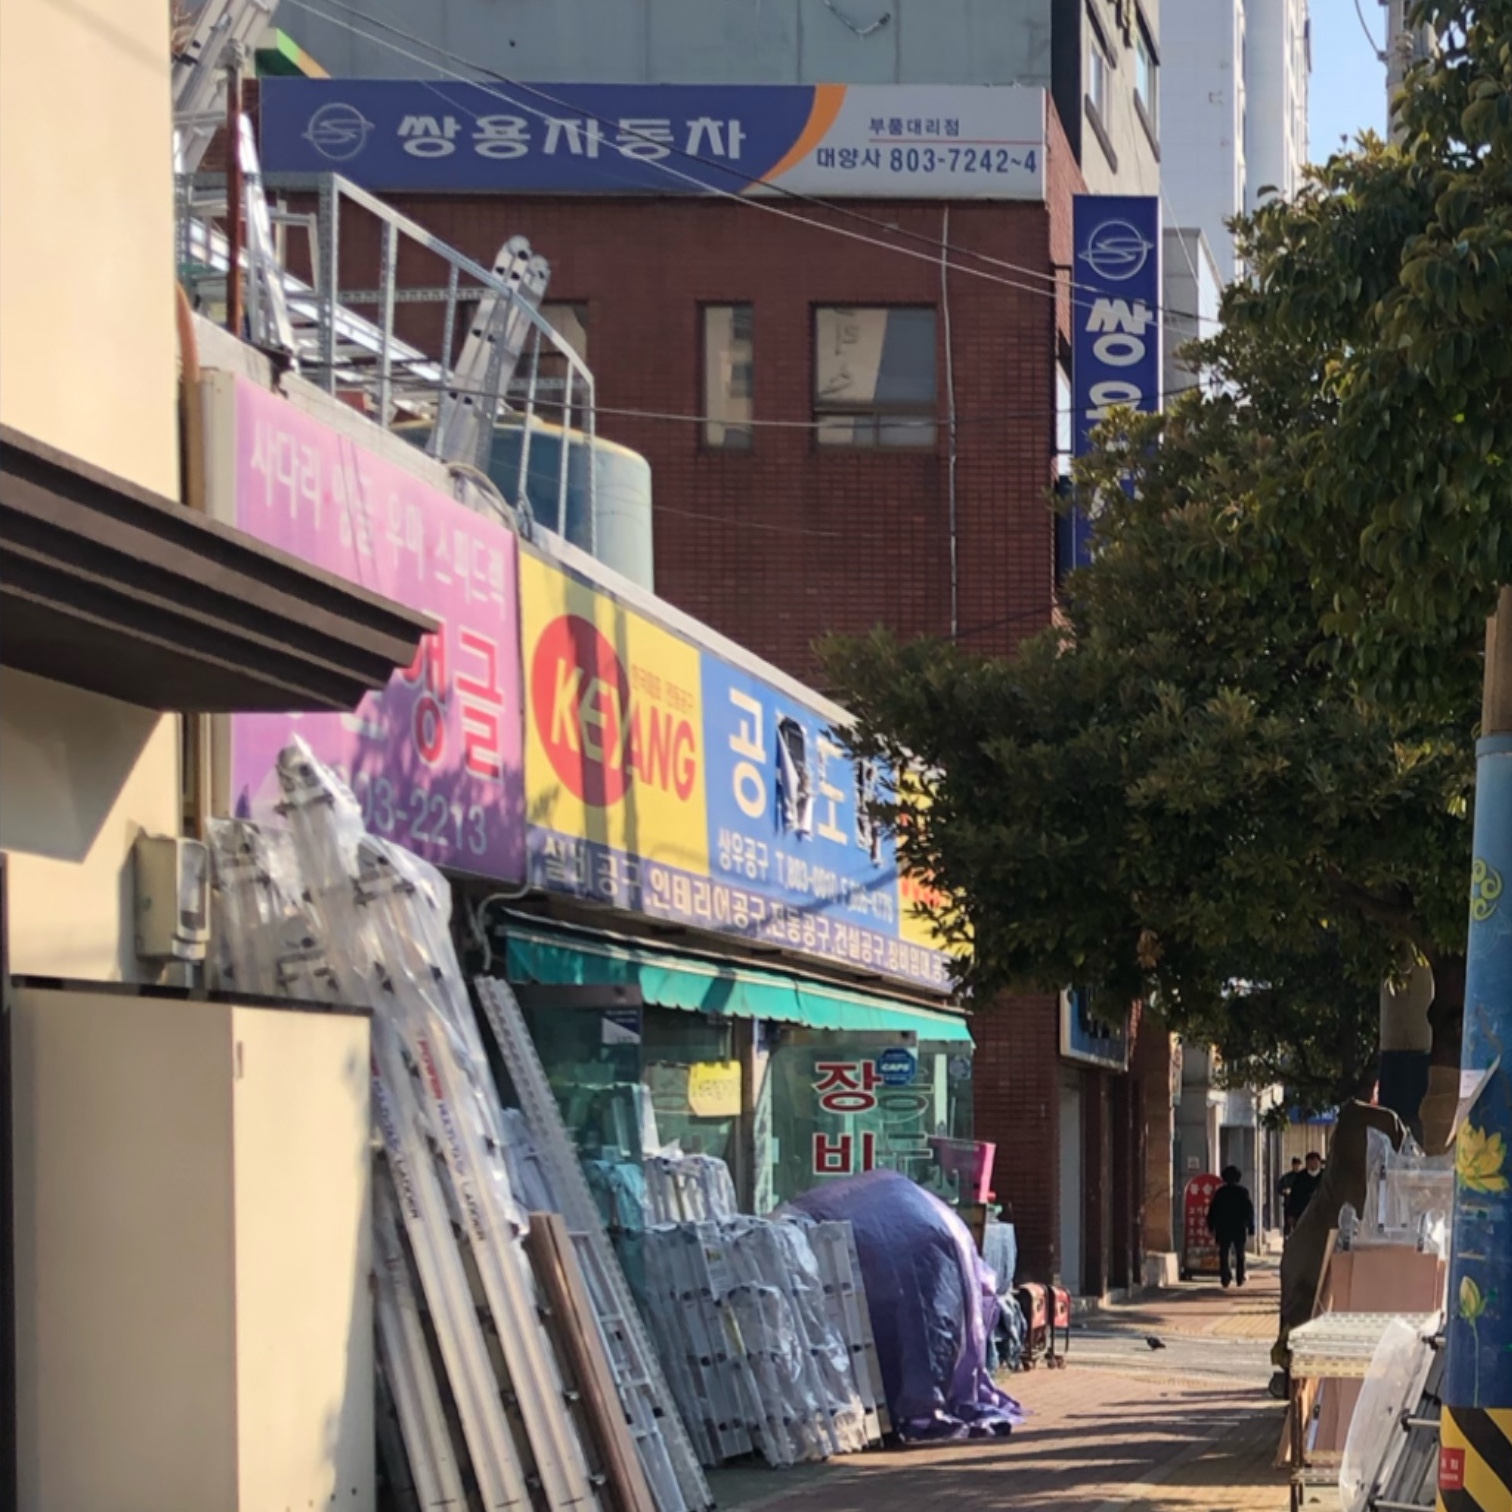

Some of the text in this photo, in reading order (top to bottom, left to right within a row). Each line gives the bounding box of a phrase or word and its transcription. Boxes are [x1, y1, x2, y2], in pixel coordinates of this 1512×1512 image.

[397, 114, 747, 160] 쌍용자동차
[869, 117, 961, 137] 부품대리점
[816, 147, 1038, 174] 대양사 803-7242~4
[250, 419, 324, 532] 사다리
[551, 656, 696, 802] KEYANG
